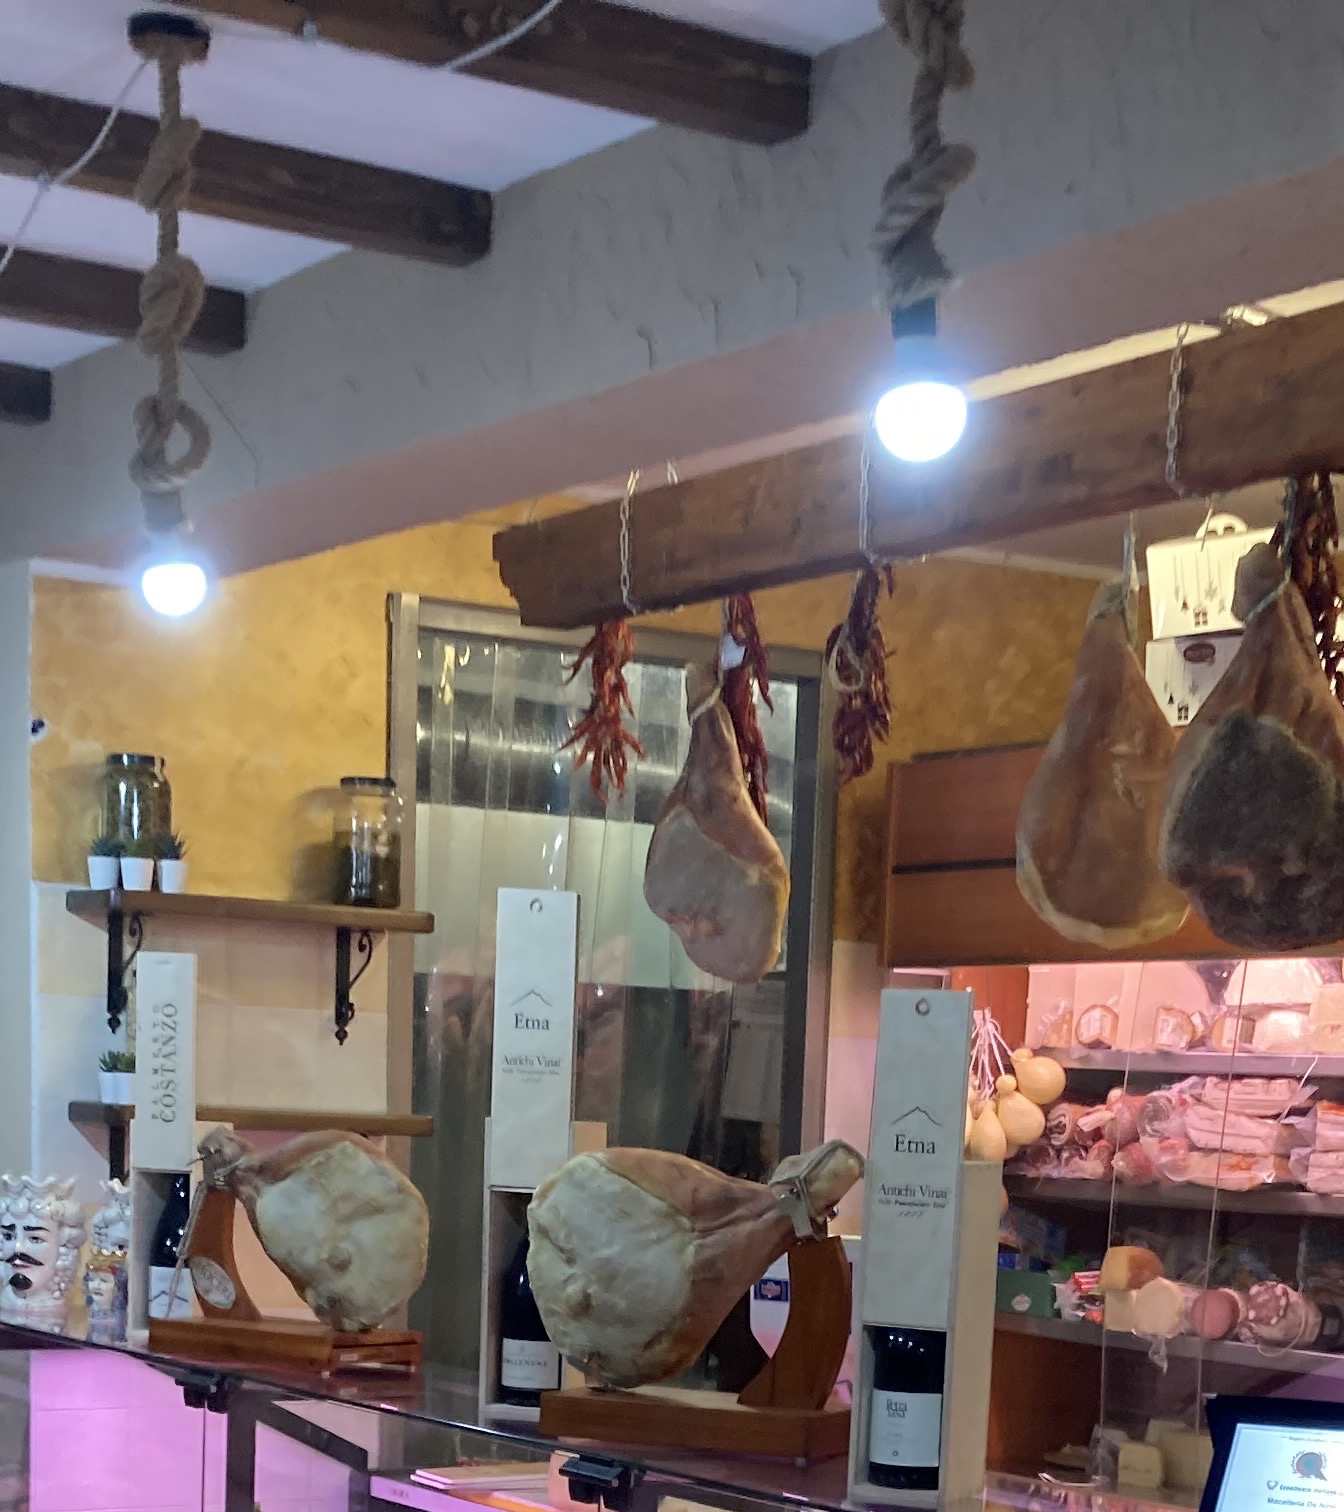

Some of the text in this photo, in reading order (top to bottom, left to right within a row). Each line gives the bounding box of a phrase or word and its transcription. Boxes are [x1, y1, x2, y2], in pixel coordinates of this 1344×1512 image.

[513, 1012, 550, 1031] Etna
[159, 1003, 178, 1123] COSTANZO
[894, 1133, 936, 1155] Etna
